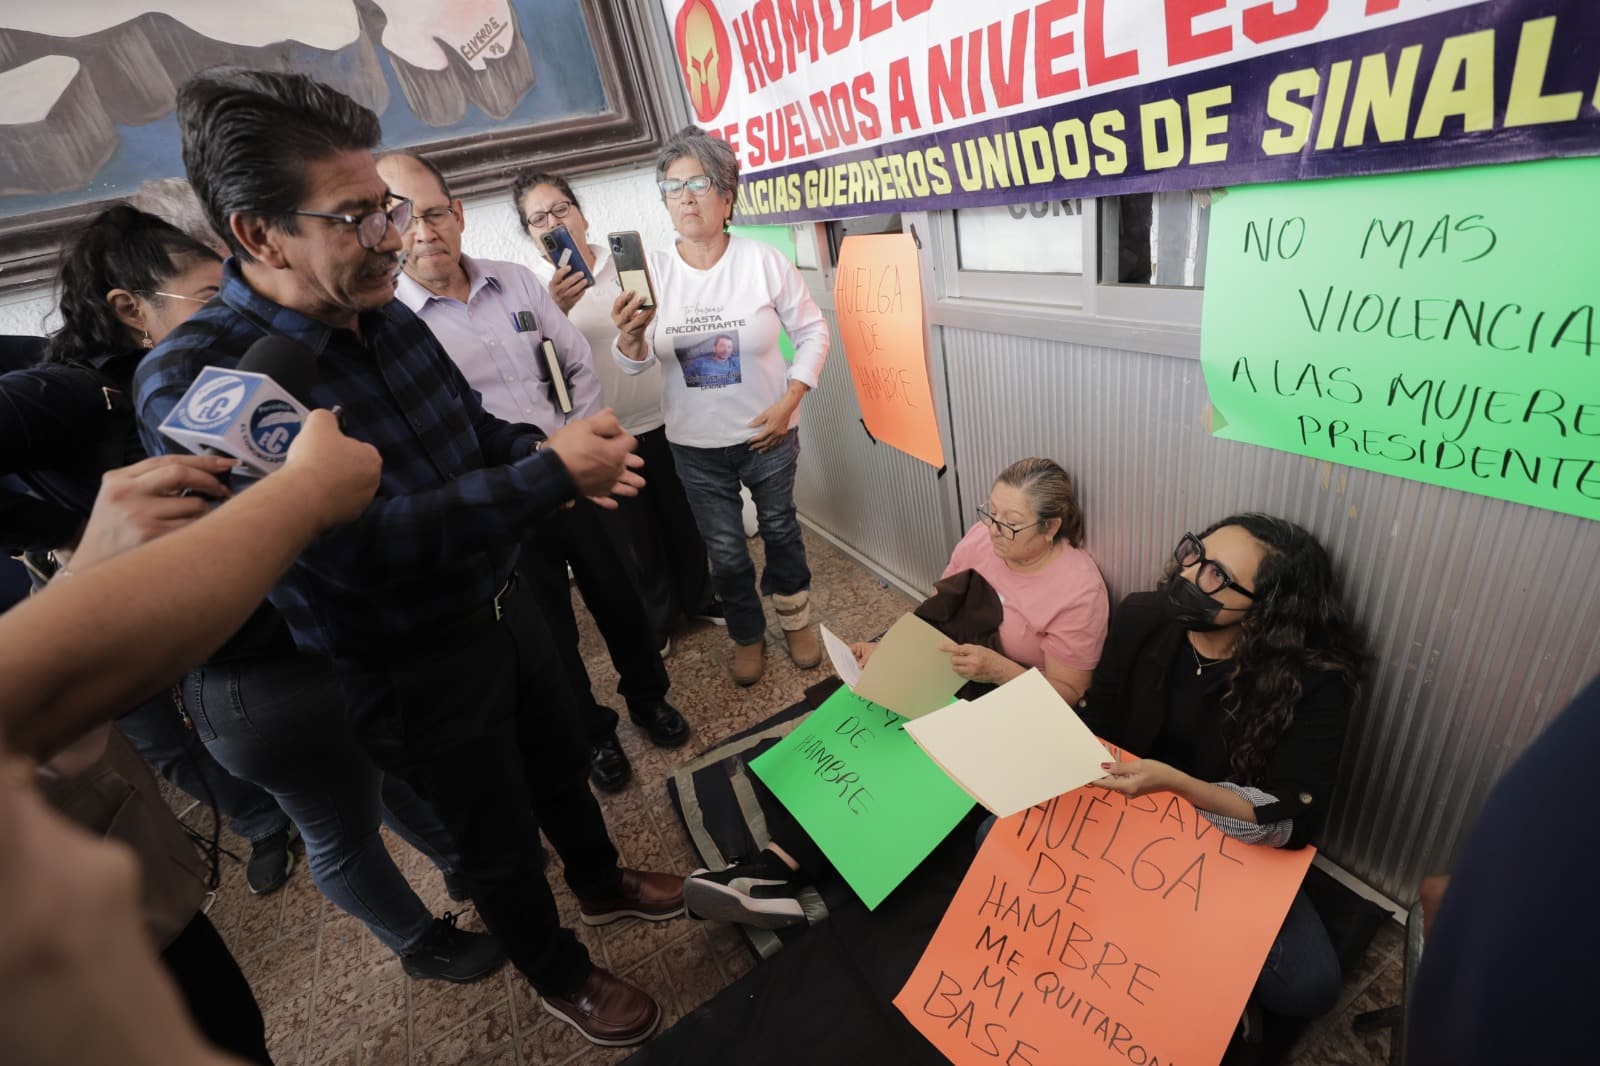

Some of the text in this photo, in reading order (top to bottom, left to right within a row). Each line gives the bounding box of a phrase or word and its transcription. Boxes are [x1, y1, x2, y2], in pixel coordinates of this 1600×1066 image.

[706, 122, 742, 170] E
[746, 71, 881, 167] SUELDOS
[889, 56, 921, 134] A
[928, 0, 1139, 124] NIVEL
[804, 142, 946, 209] GUERREROS
[954, 109, 1128, 192] UNIDOS
[1139, 84, 1232, 171] DE
[1262, 15, 1600, 156] SINAL
[1243, 214, 1498, 269] NO MAS
[685, 314, 723, 325] HASTA
[835, 263, 904, 321] HUELGA
[1298, 285, 1600, 357] VIOLENCIA
[665, 318, 747, 335] ENCONTRARTE
[857, 319, 884, 356] DE
[1232, 356, 1258, 393] A
[1273, 359, 1363, 404] LAS
[1297, 414, 1600, 501] PRESIDENTE
[835, 716, 876, 749] DE
[794, 734, 875, 816] HAMBRE
[1016, 795, 1209, 912] HUELGA
[1028, 851, 1095, 912] DE
[975, 924, 1025, 977] ME
[978, 874, 1161, 1006] HAMBRE
[923, 969, 1040, 1066] BASE
[972, 964, 1024, 1019] MI
